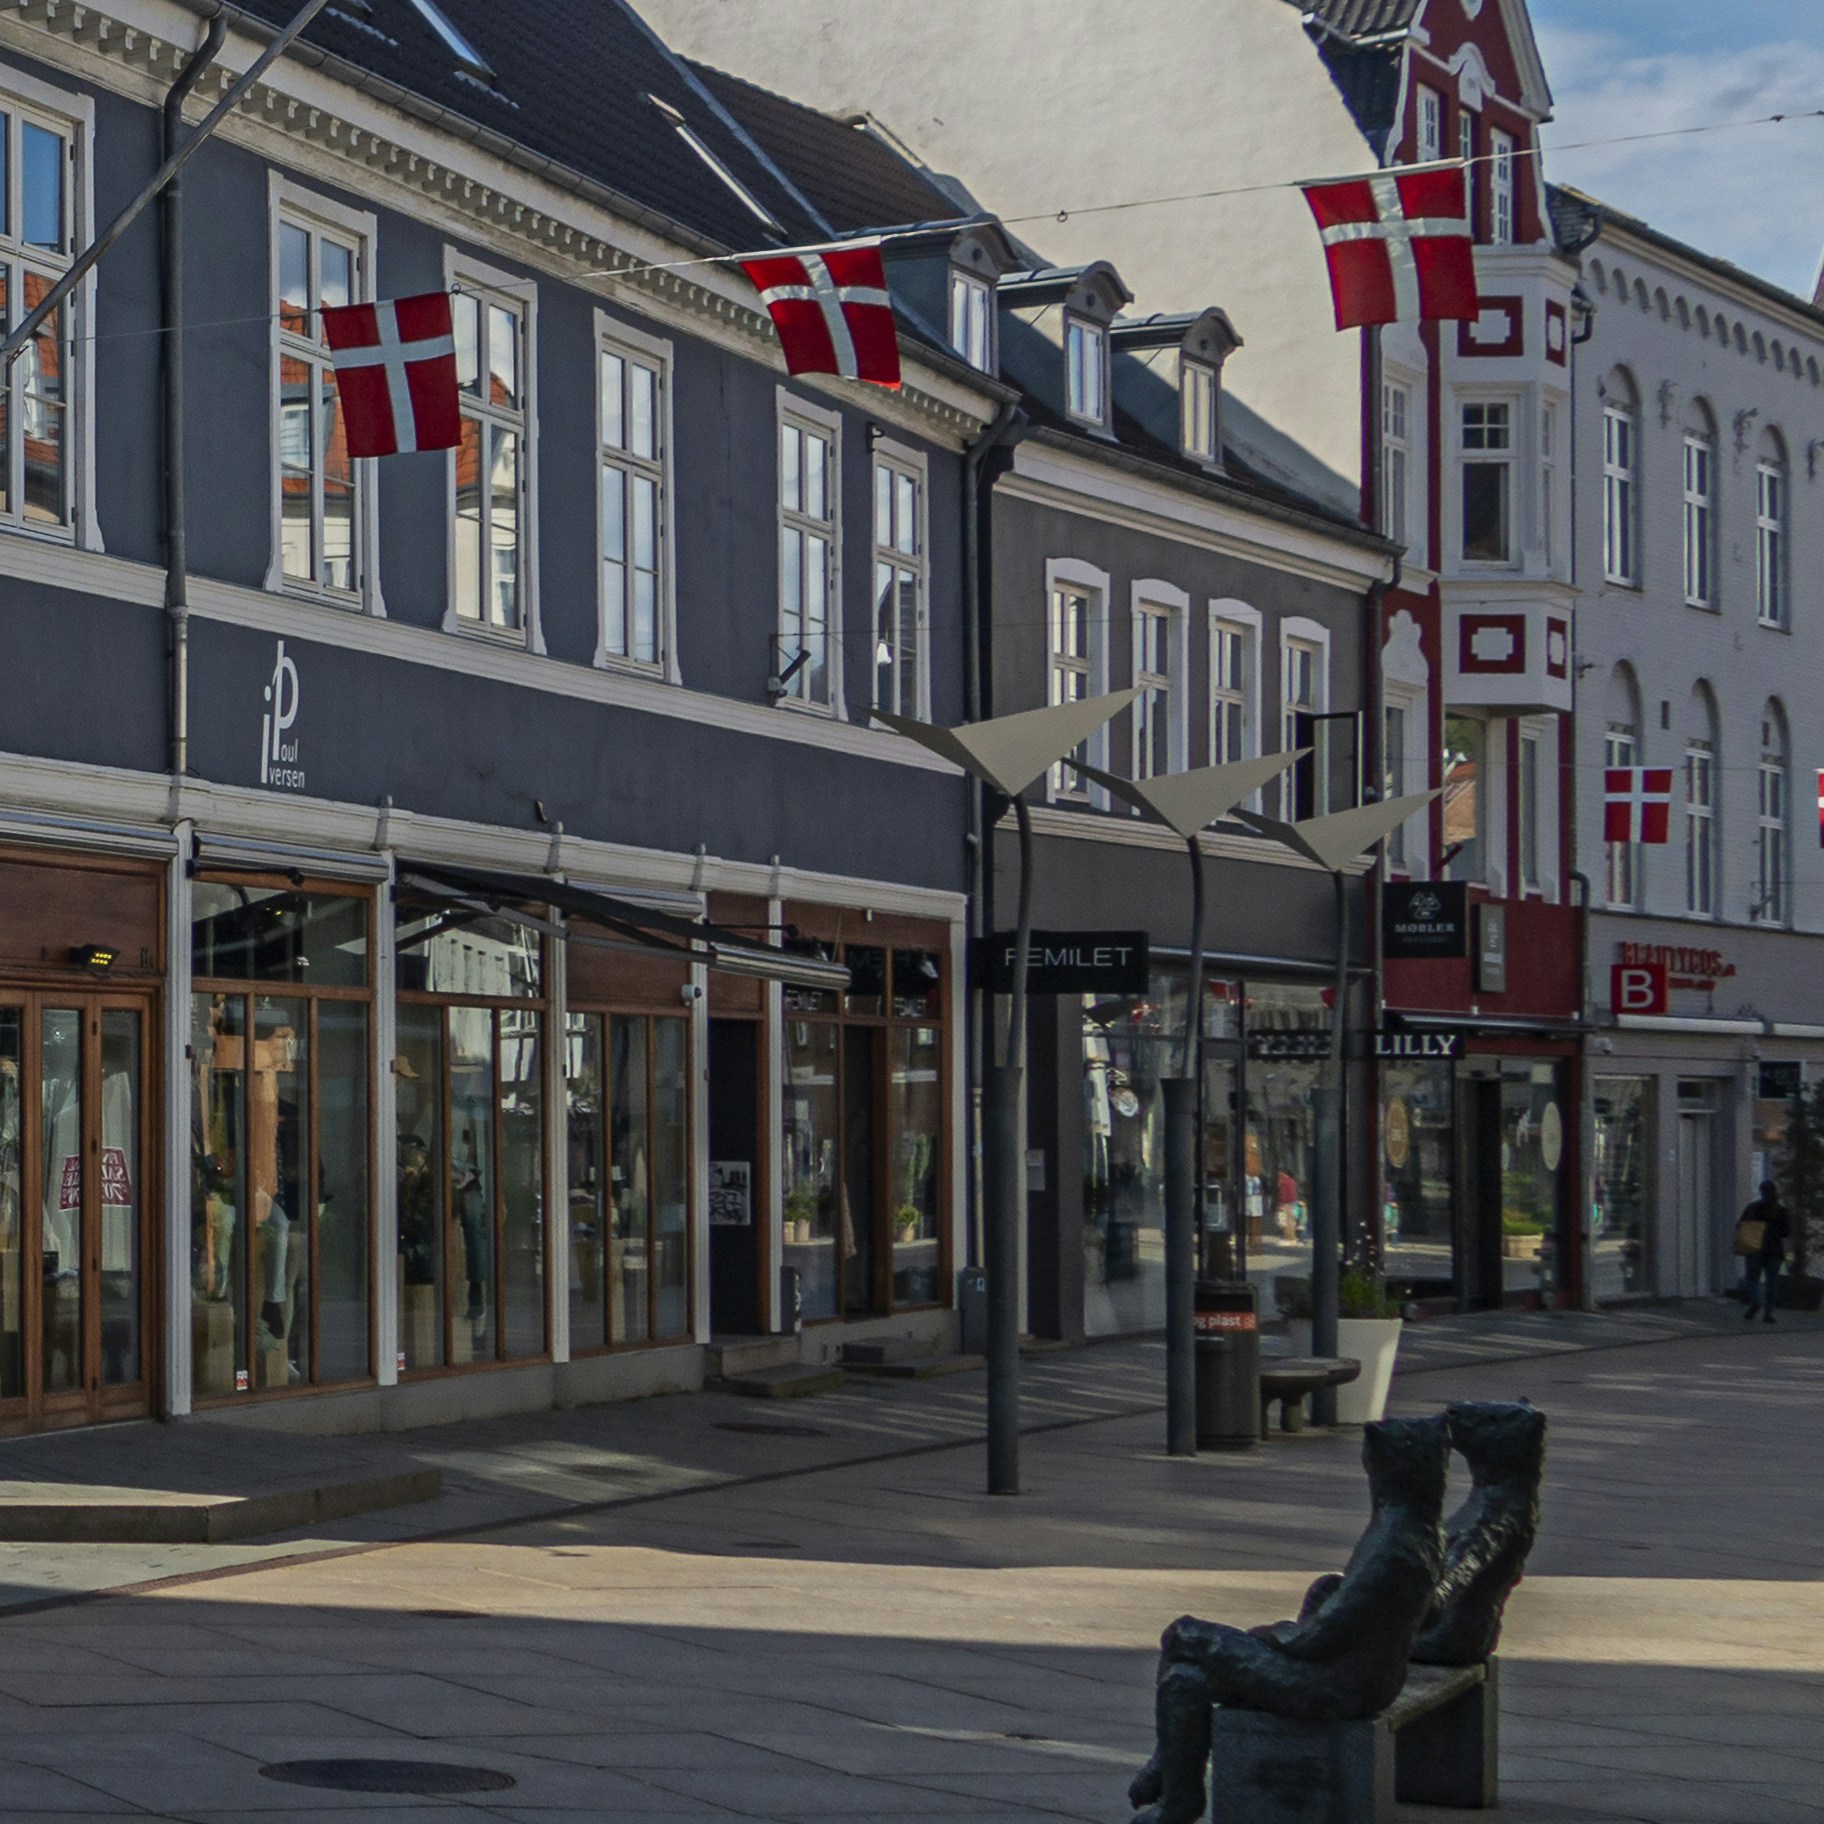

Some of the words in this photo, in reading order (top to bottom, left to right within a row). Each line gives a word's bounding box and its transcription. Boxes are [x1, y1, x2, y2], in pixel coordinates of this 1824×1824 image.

[1005, 947, 1132, 966] FEMILET
[1621, 969, 1654, 1009] B
[1375, 1035, 1456, 1055] LILLY
[1209, 1314, 1240, 1329] plast
